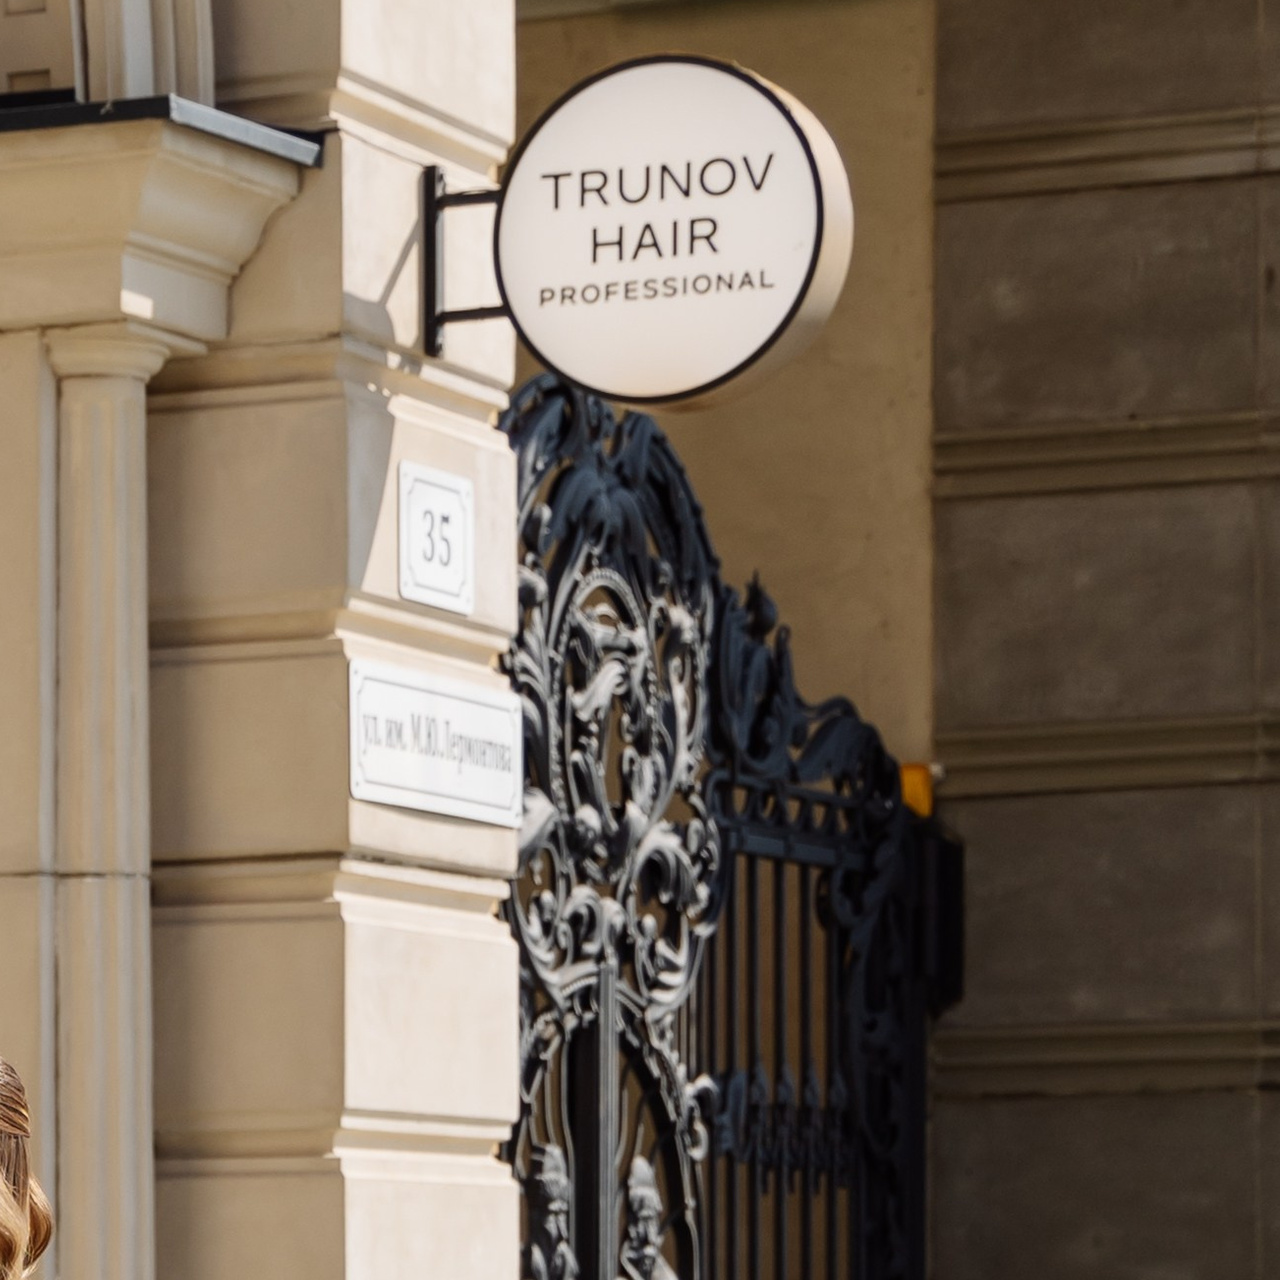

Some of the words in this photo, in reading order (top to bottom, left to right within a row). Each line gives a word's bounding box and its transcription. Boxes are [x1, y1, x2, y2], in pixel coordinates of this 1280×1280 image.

[541, 153, 775, 210] TRUNOV
[592, 217, 719, 264] HAIR
[539, 269, 775, 307] PROFESSIONAL
[422, 510, 451, 568] 35
